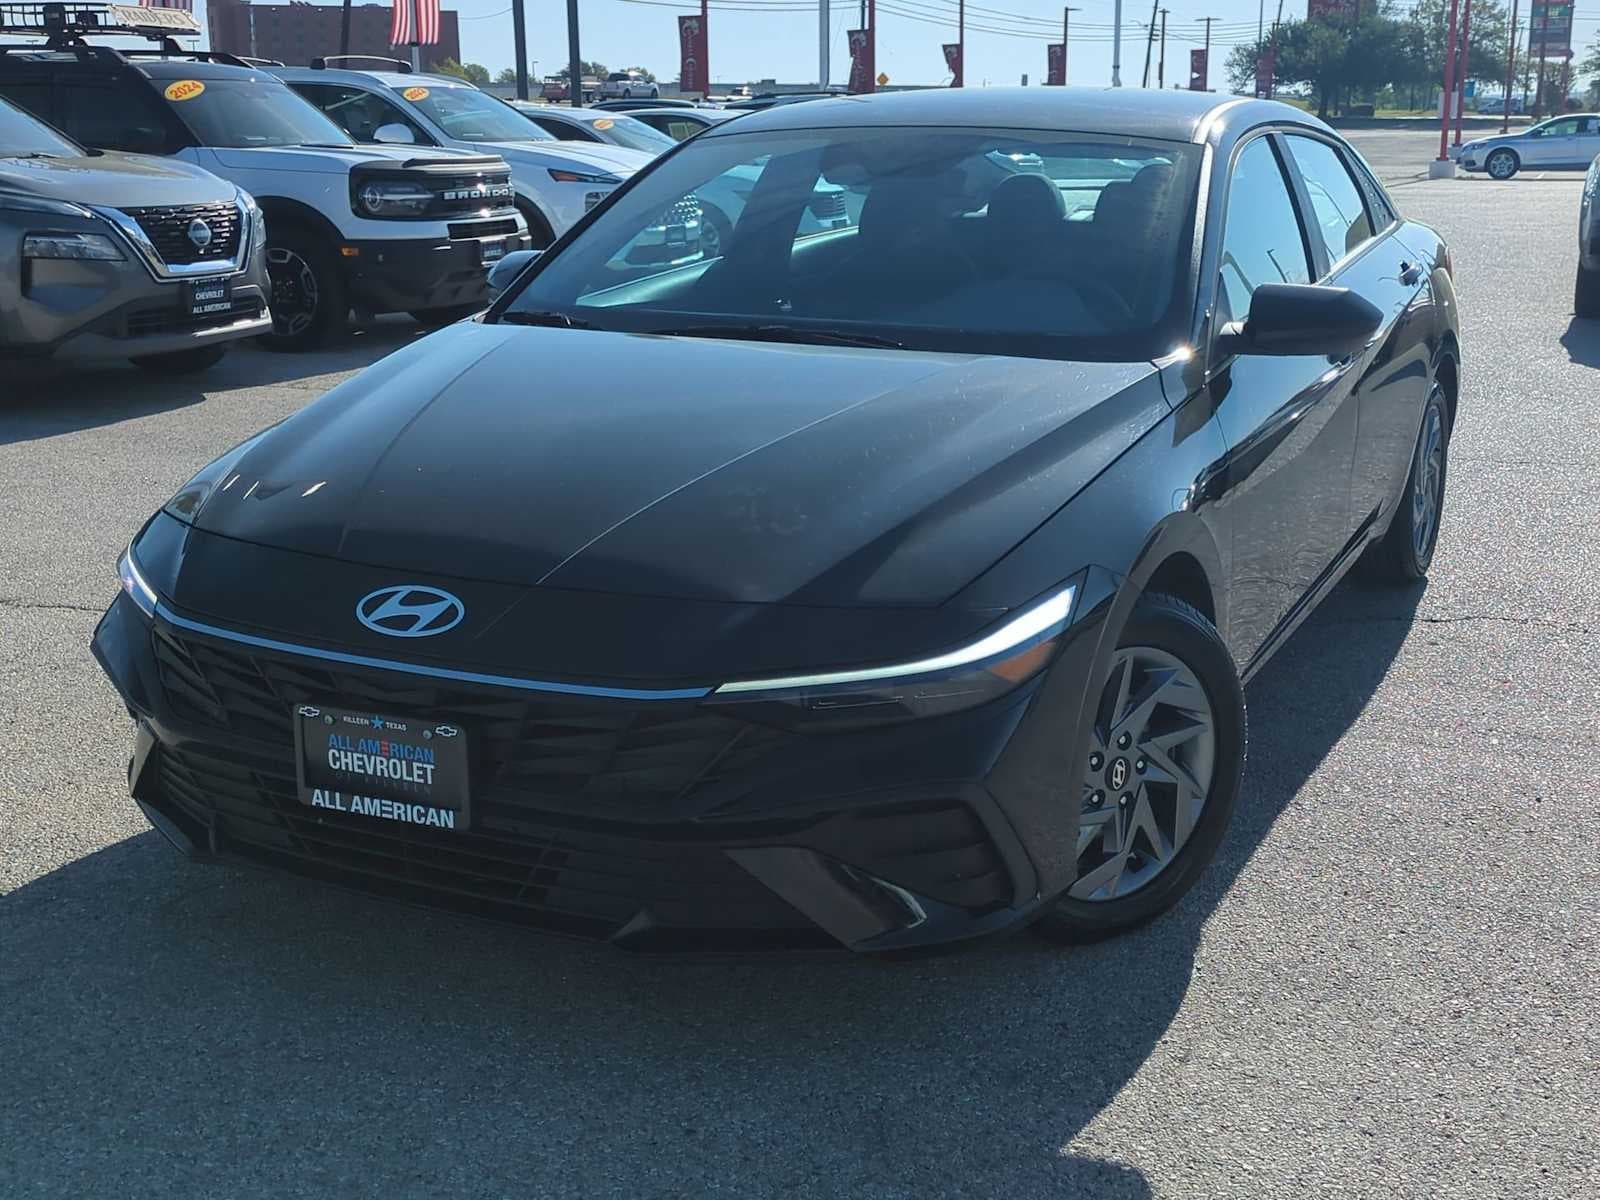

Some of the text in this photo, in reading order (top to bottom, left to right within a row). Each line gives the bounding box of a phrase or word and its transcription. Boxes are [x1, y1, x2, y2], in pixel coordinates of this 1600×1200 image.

[169, 82, 202, 99] 2024
[443, 188, 509, 200] BRONCO
[343, 715, 407, 732] KILLEEN TEXAS
[328, 734, 435, 763] ALL AMERICAN
[328, 749, 435, 785] CHEVROLET
[311, 788, 455, 829] ALL AMERICAN
